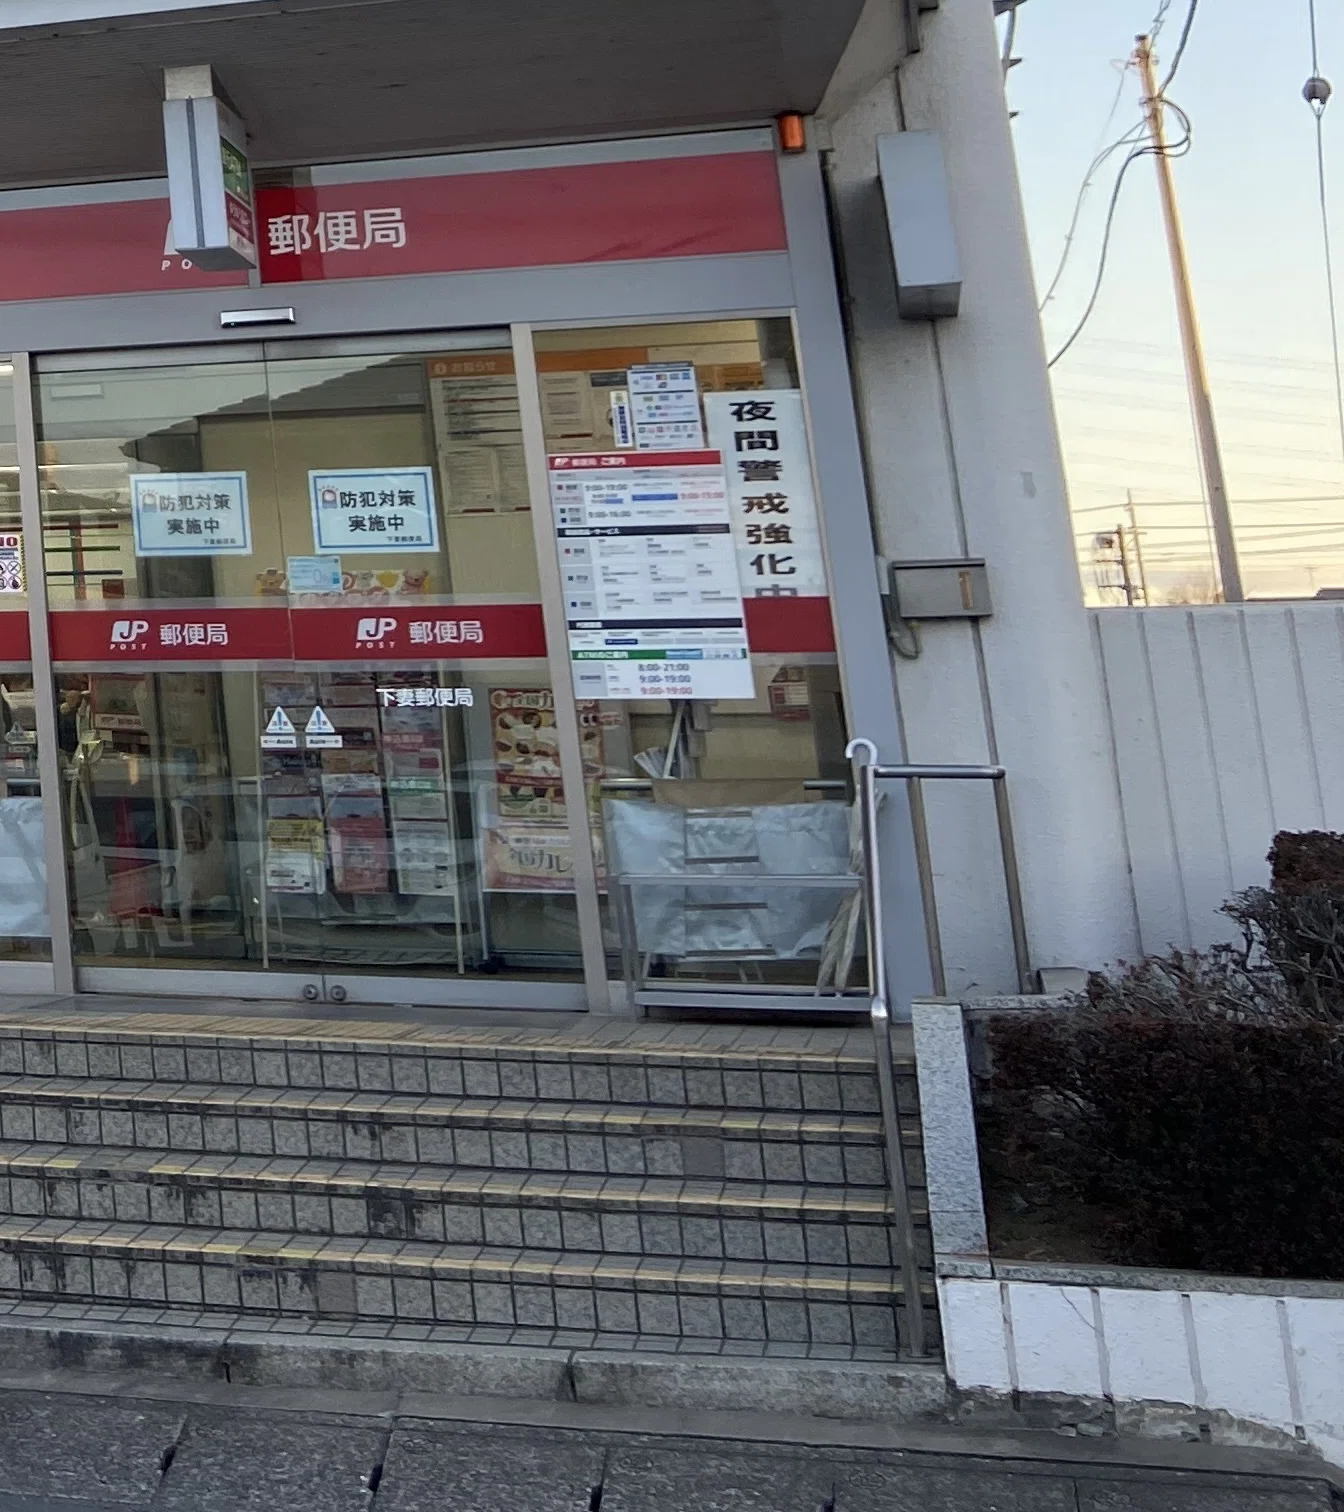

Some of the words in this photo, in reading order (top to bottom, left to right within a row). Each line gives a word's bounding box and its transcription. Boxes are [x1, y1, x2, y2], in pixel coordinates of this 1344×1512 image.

[268, 206, 407, 256] 郵便局
[161, 258, 193, 271] PO
[159, 494, 232, 512] 防犯対策
[339, 489, 416, 509] 防犯対策
[166, 517, 221, 536] 実施中
[348, 514, 405, 532] 実施中
[158, 622, 229, 646] 郵便局
[408, 620, 484, 644] 郵便局
[109, 643, 148, 651] POST
[355, 641, 396, 649] POST
[375, 687, 474, 708] 下妻郵便局
